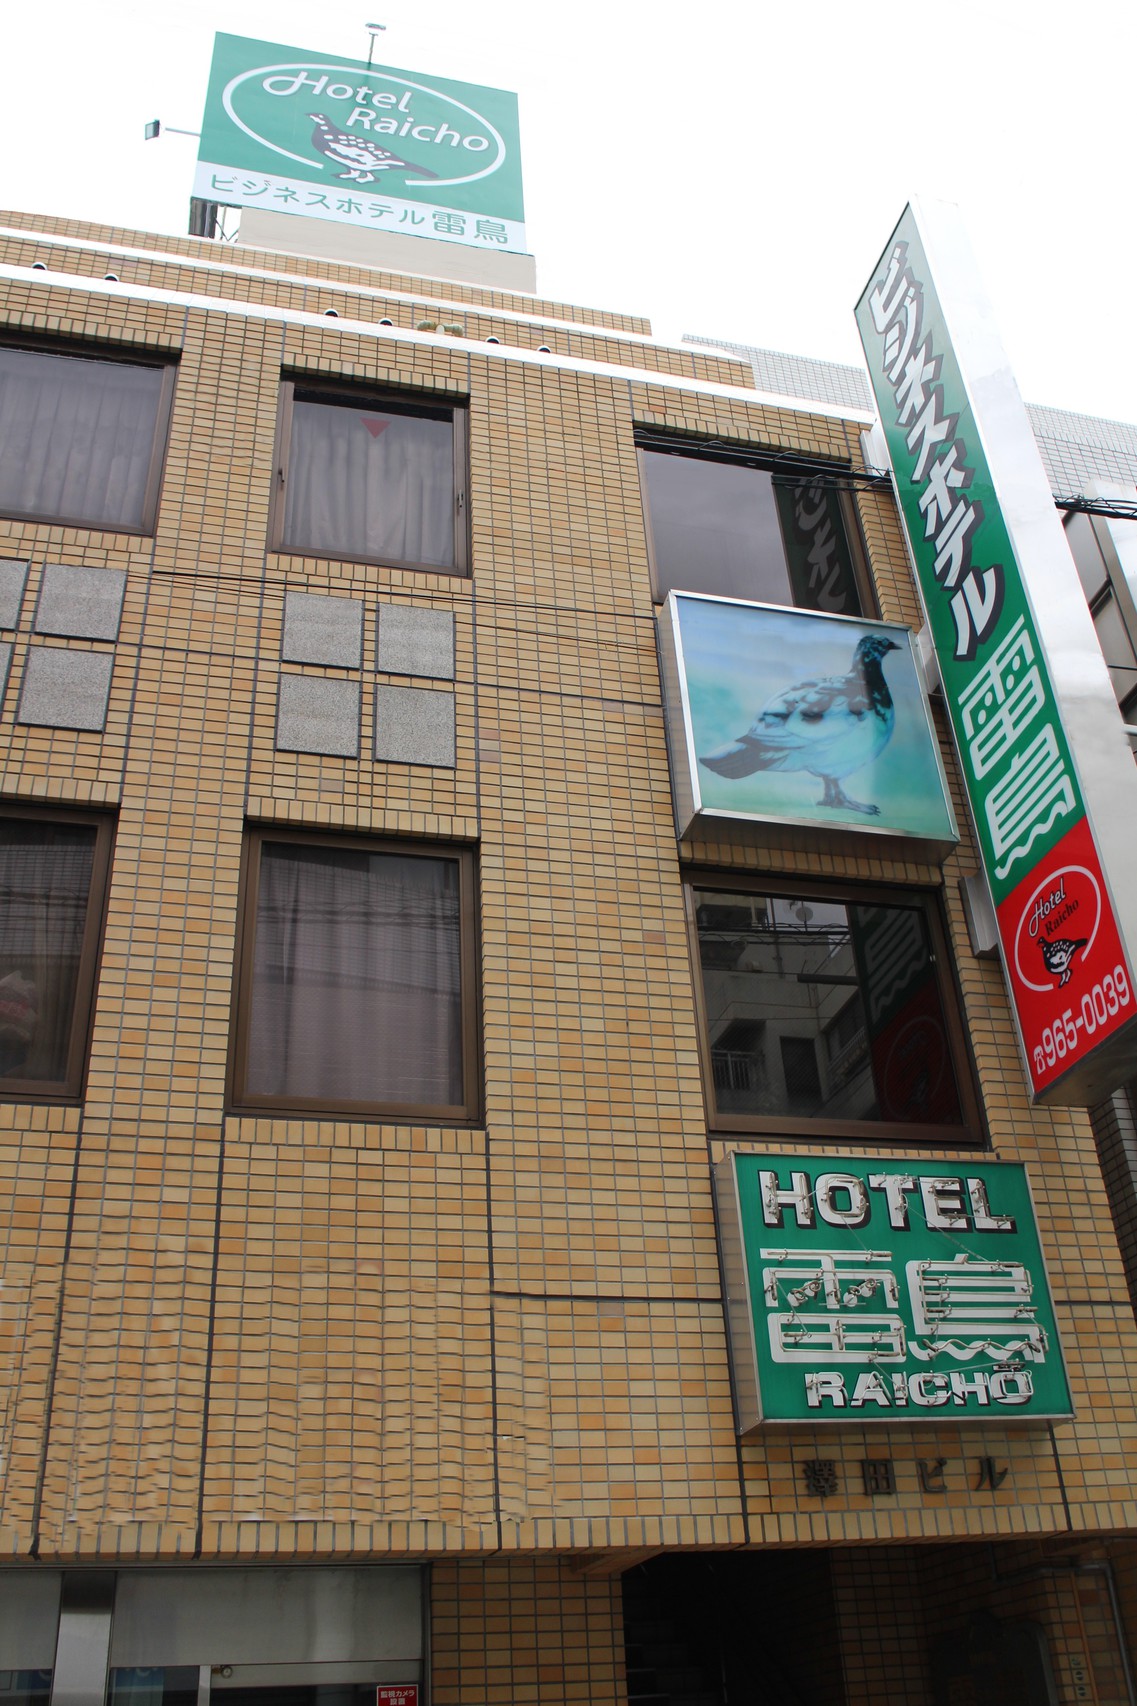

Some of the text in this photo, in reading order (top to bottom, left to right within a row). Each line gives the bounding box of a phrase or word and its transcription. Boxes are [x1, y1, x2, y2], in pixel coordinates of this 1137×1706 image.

[262, 71, 412, 113] Hotel
[345, 107, 490, 152] Raicho
[1029, 877, 1065, 937] Hotel
[1044, 898, 1079, 937] Raicho
[758, 1170, 1018, 1234] HOTEL
[760, 1248, 1048, 1363] 雷鳥
[803, 1369, 1034, 1408] RAICHO
[803, 1457, 1009, 1497] 澤田ビル
[380, 1690, 415, 1698] 監視カメラ
